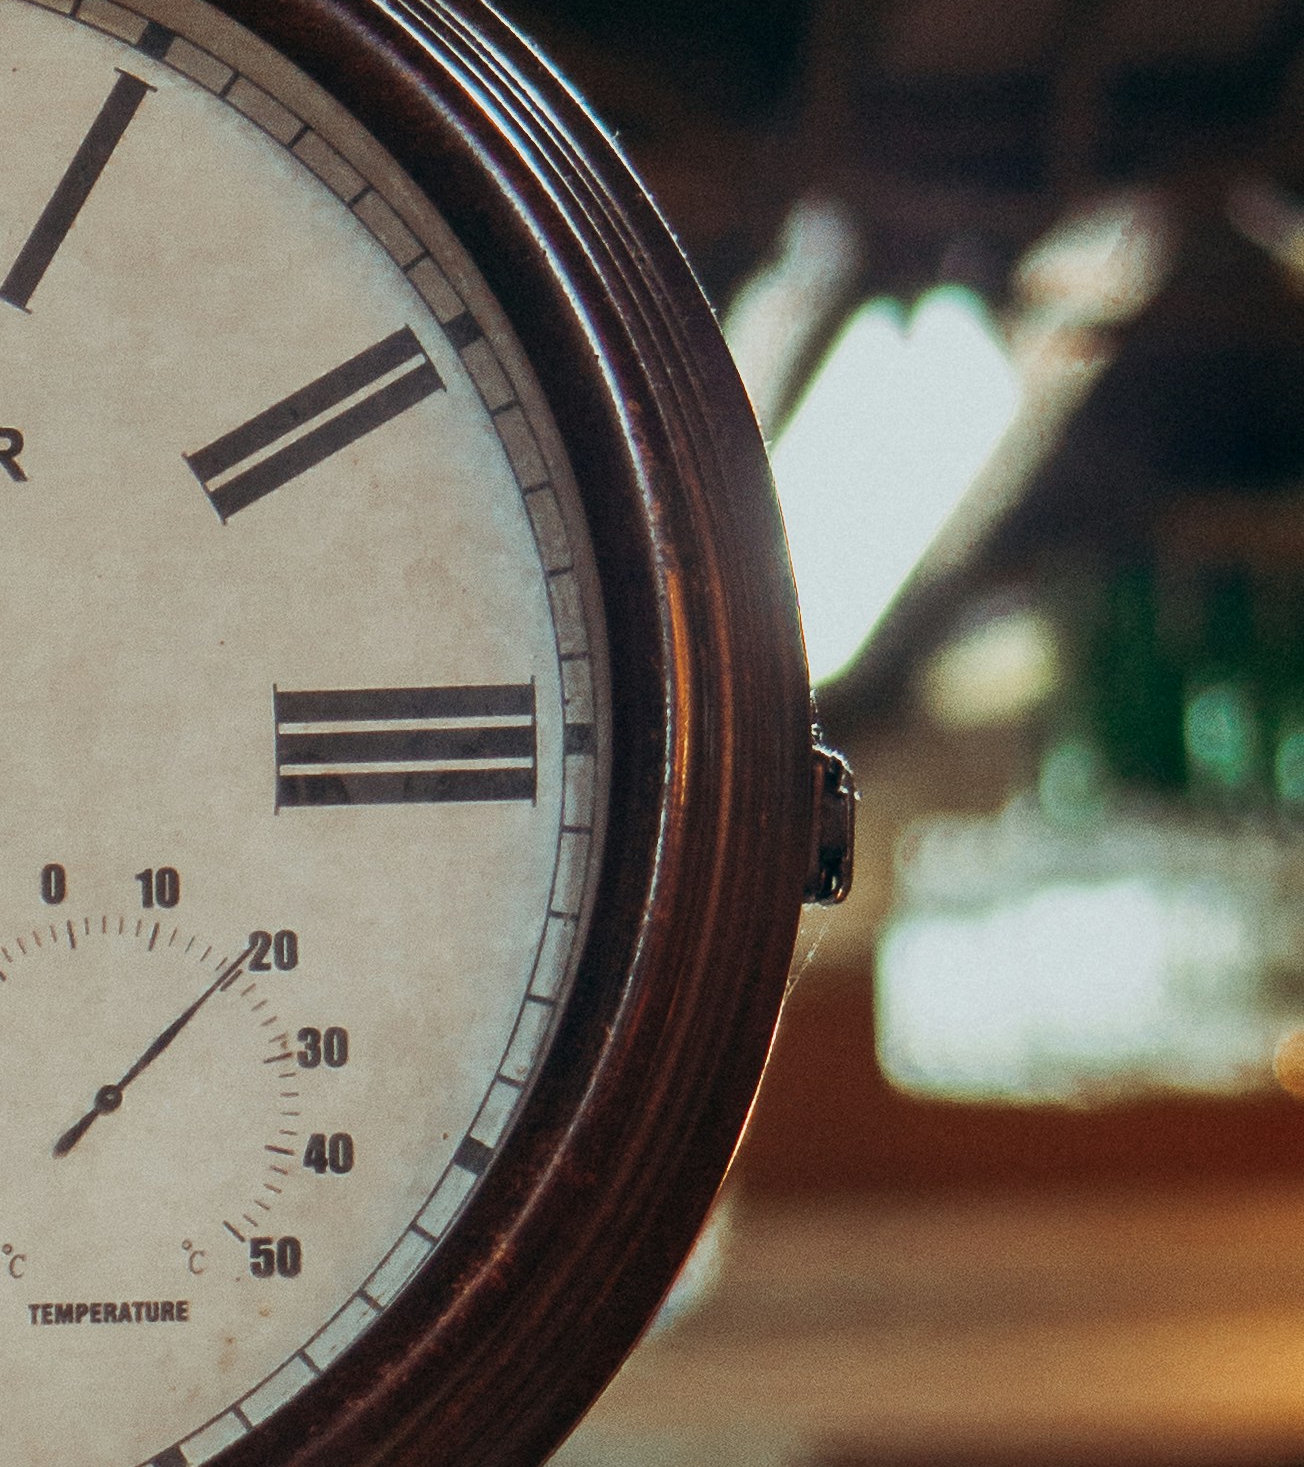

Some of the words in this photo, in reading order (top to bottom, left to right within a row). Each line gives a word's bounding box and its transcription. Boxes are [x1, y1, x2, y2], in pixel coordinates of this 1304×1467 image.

[183, 325, 446, 523] II
[274, 677, 536, 813] III
[41, 864, 66, 904] 0
[136, 867, 179, 908] 10
[249, 930, 298, 971] 20
[298, 1027, 348, 1068] 30
[303, 1133, 354, 1173] 40
[250, 1236, 301, 1278] 50
[29, 1301, 188, 1325] TEMPERATURE
